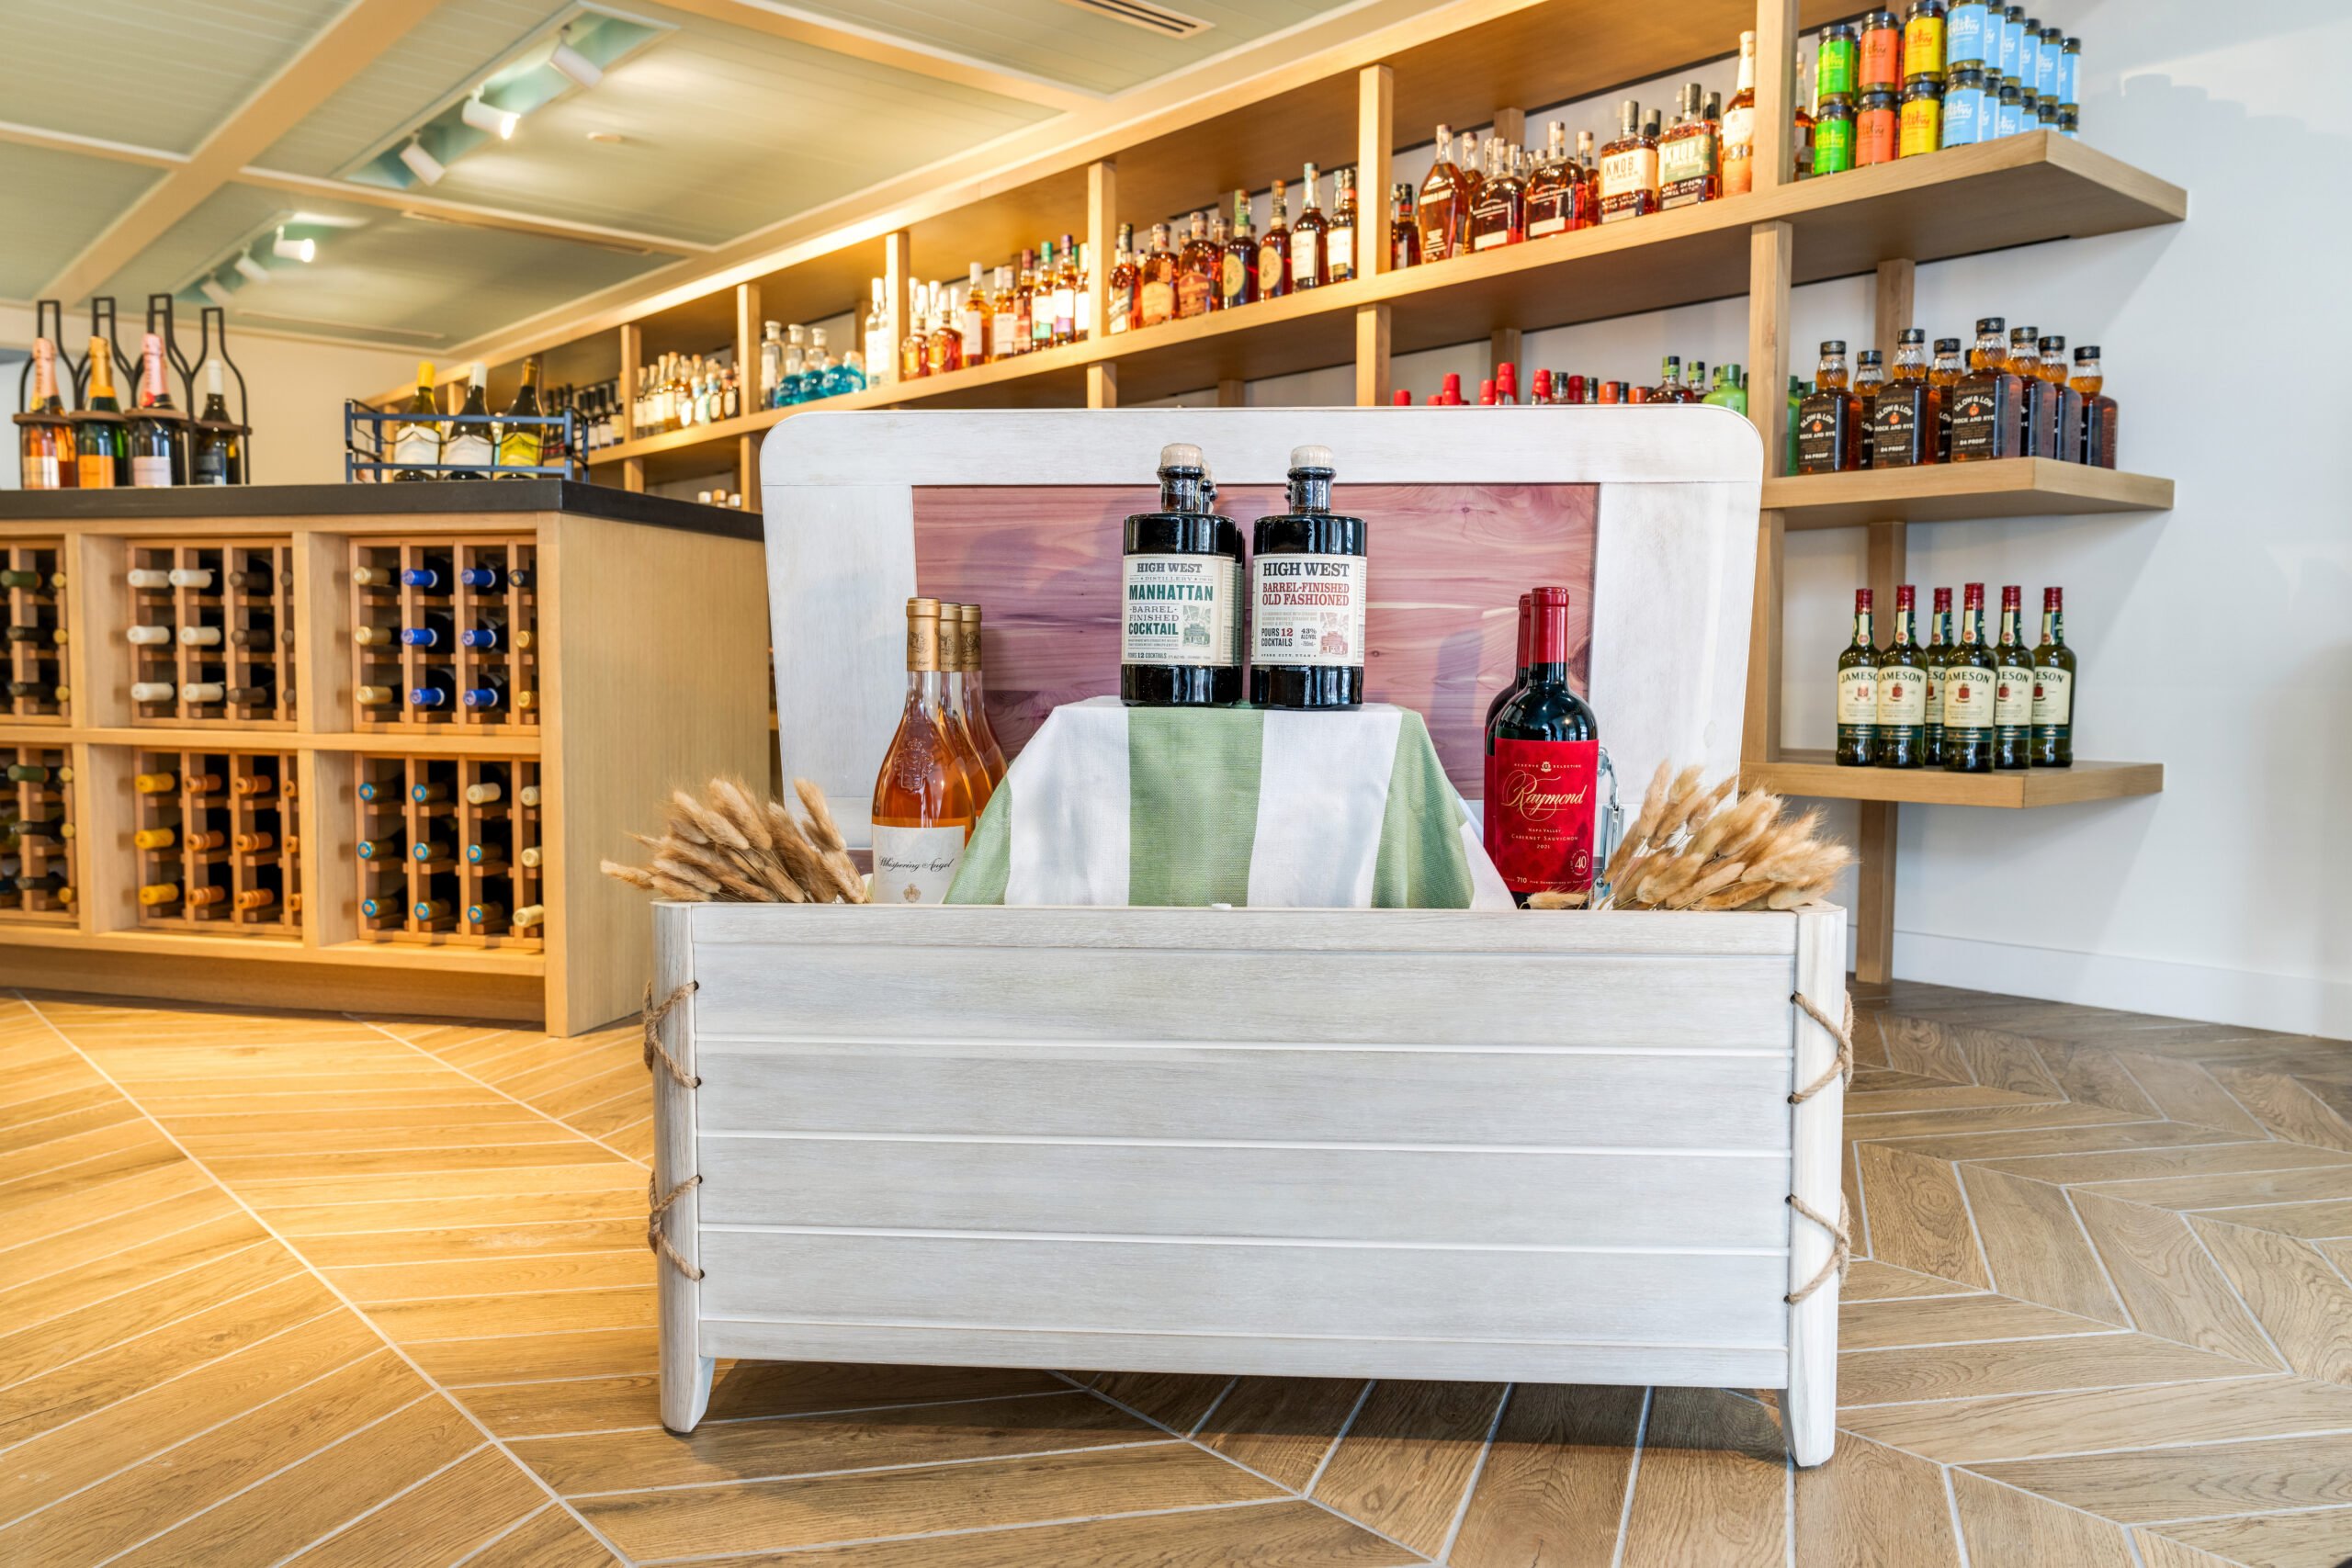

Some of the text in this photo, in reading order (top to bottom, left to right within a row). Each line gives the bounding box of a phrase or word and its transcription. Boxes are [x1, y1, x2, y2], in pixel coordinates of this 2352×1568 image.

[1606, 156, 1634, 176] KNOB
[1136, 562, 1203, 573] HIGH WEST
[1262, 562, 1350, 577] HIGH WEST
[1129, 584, 1213, 602] MANHATTAN
[1262, 582, 1350, 593] BARREL-FINISHED
[1262, 593, 1350, 606] OLD FASHIONED
[1129, 614, 1180, 622] FINISHED
[1128, 623, 1179, 636] COCKTAIL
[1261, 627, 1294, 637] POURS 12
[1261, 637, 1293, 647] COCKTAILS
[1841, 671, 1878, 684] JAMES
[1879, 671, 1922, 683] JAMESON
[1945, 671, 1991, 684] JAMESON
[2036, 671, 2064, 683] ESON
[1501, 770, 1588, 821] Raymond
[879, 856, 955, 873] Whispering Angel
[1574, 855, 1587, 869] 40
